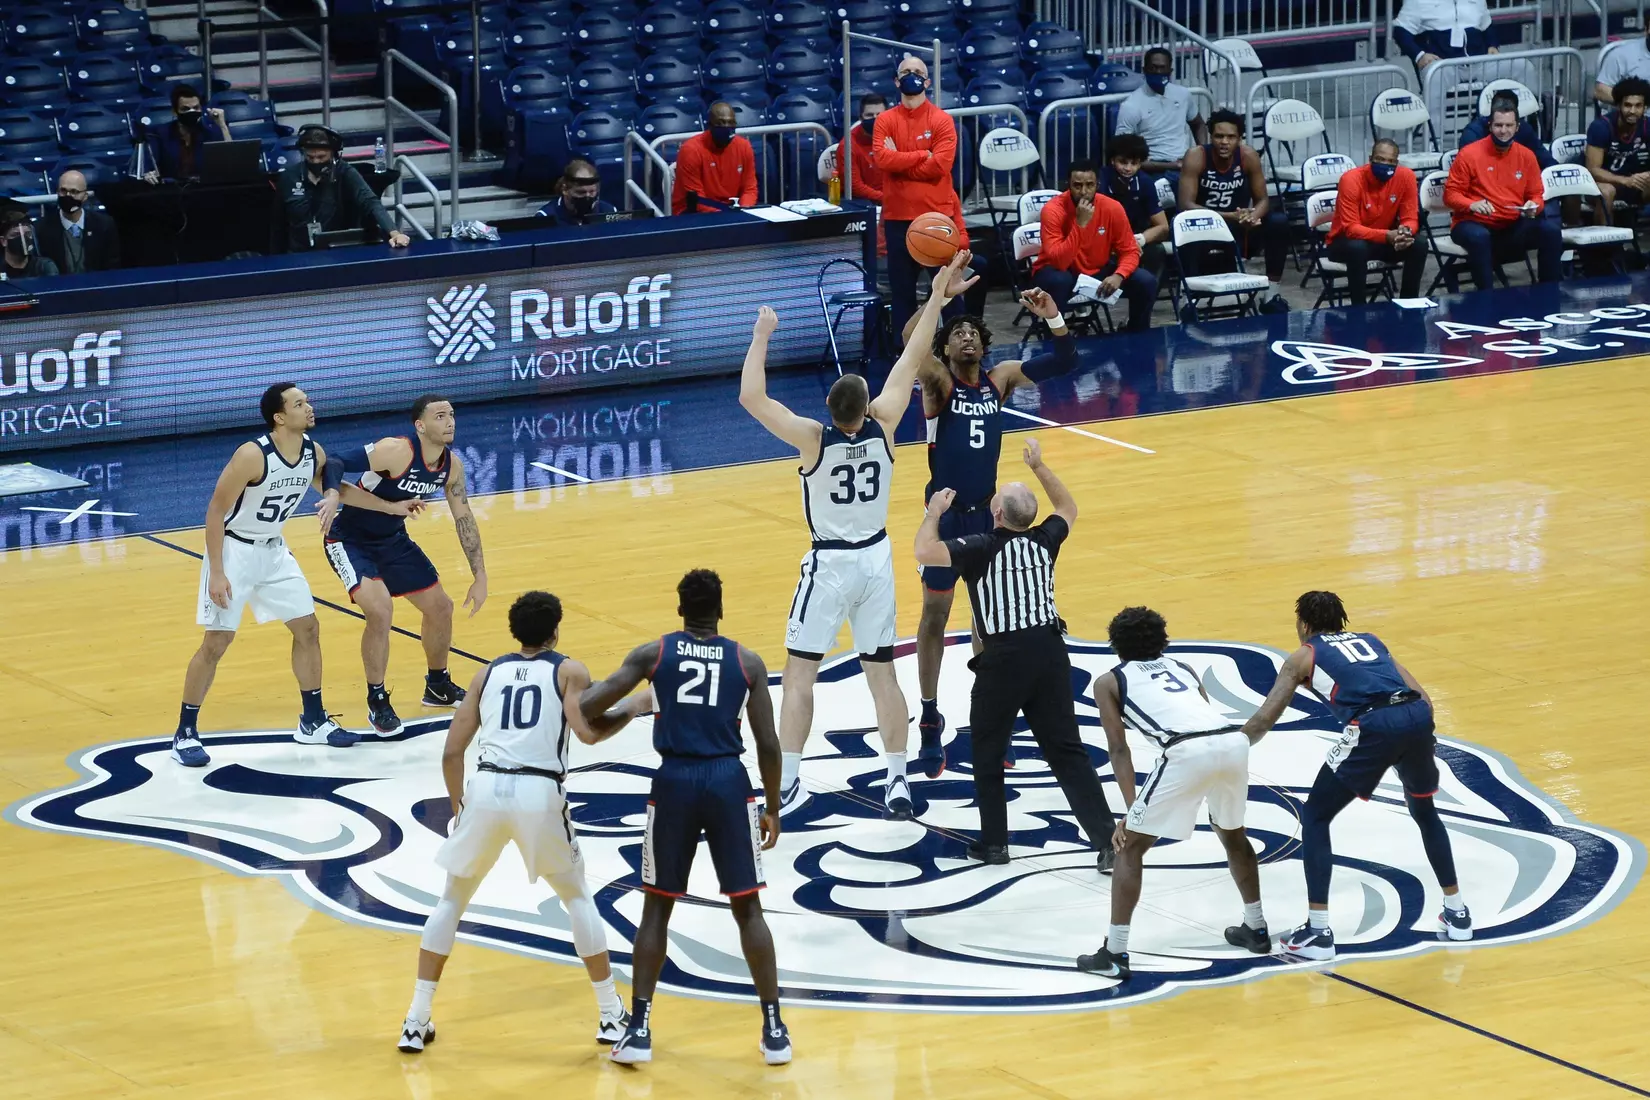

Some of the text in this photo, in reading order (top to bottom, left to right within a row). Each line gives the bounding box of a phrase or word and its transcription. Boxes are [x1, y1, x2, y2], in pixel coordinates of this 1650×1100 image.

[1378, 99, 1425, 114] BUTLER
[1271, 110, 1319, 125] BUTLER
[985, 139, 1033, 154] BUTLER
[1200, 178, 1244, 190] UCONN
[1546, 174, 1591, 188] BUTLER
[1205, 190, 1234, 208] 25
[844, 220, 867, 233] ANC
[1179, 219, 1225, 232] BUTLER
[510, 273, 672, 343] Ruoff
[1434, 303, 1650, 340] Asce
[1482, 337, 1625, 359] St.
[0, 330, 122, 396] uoff
[511, 338, 672, 381] MORTGAGE
[1, 398, 122, 437] RTGAGE
[951, 399, 998, 416] UCONN
[969, 419, 985, 449] 5
[846, 444, 868, 460] GOLDEN
[268, 477, 308, 491] BUTLER
[830, 461, 881, 505] 33
[256, 493, 301, 523] 52
[676, 640, 723, 660] SANOGO
[1328, 638, 1379, 663] 10
[515, 667, 529, 681] NZE
[676, 660, 721, 707] 21
[1150, 670, 1189, 693] 3
[500, 684, 542, 730] 10
